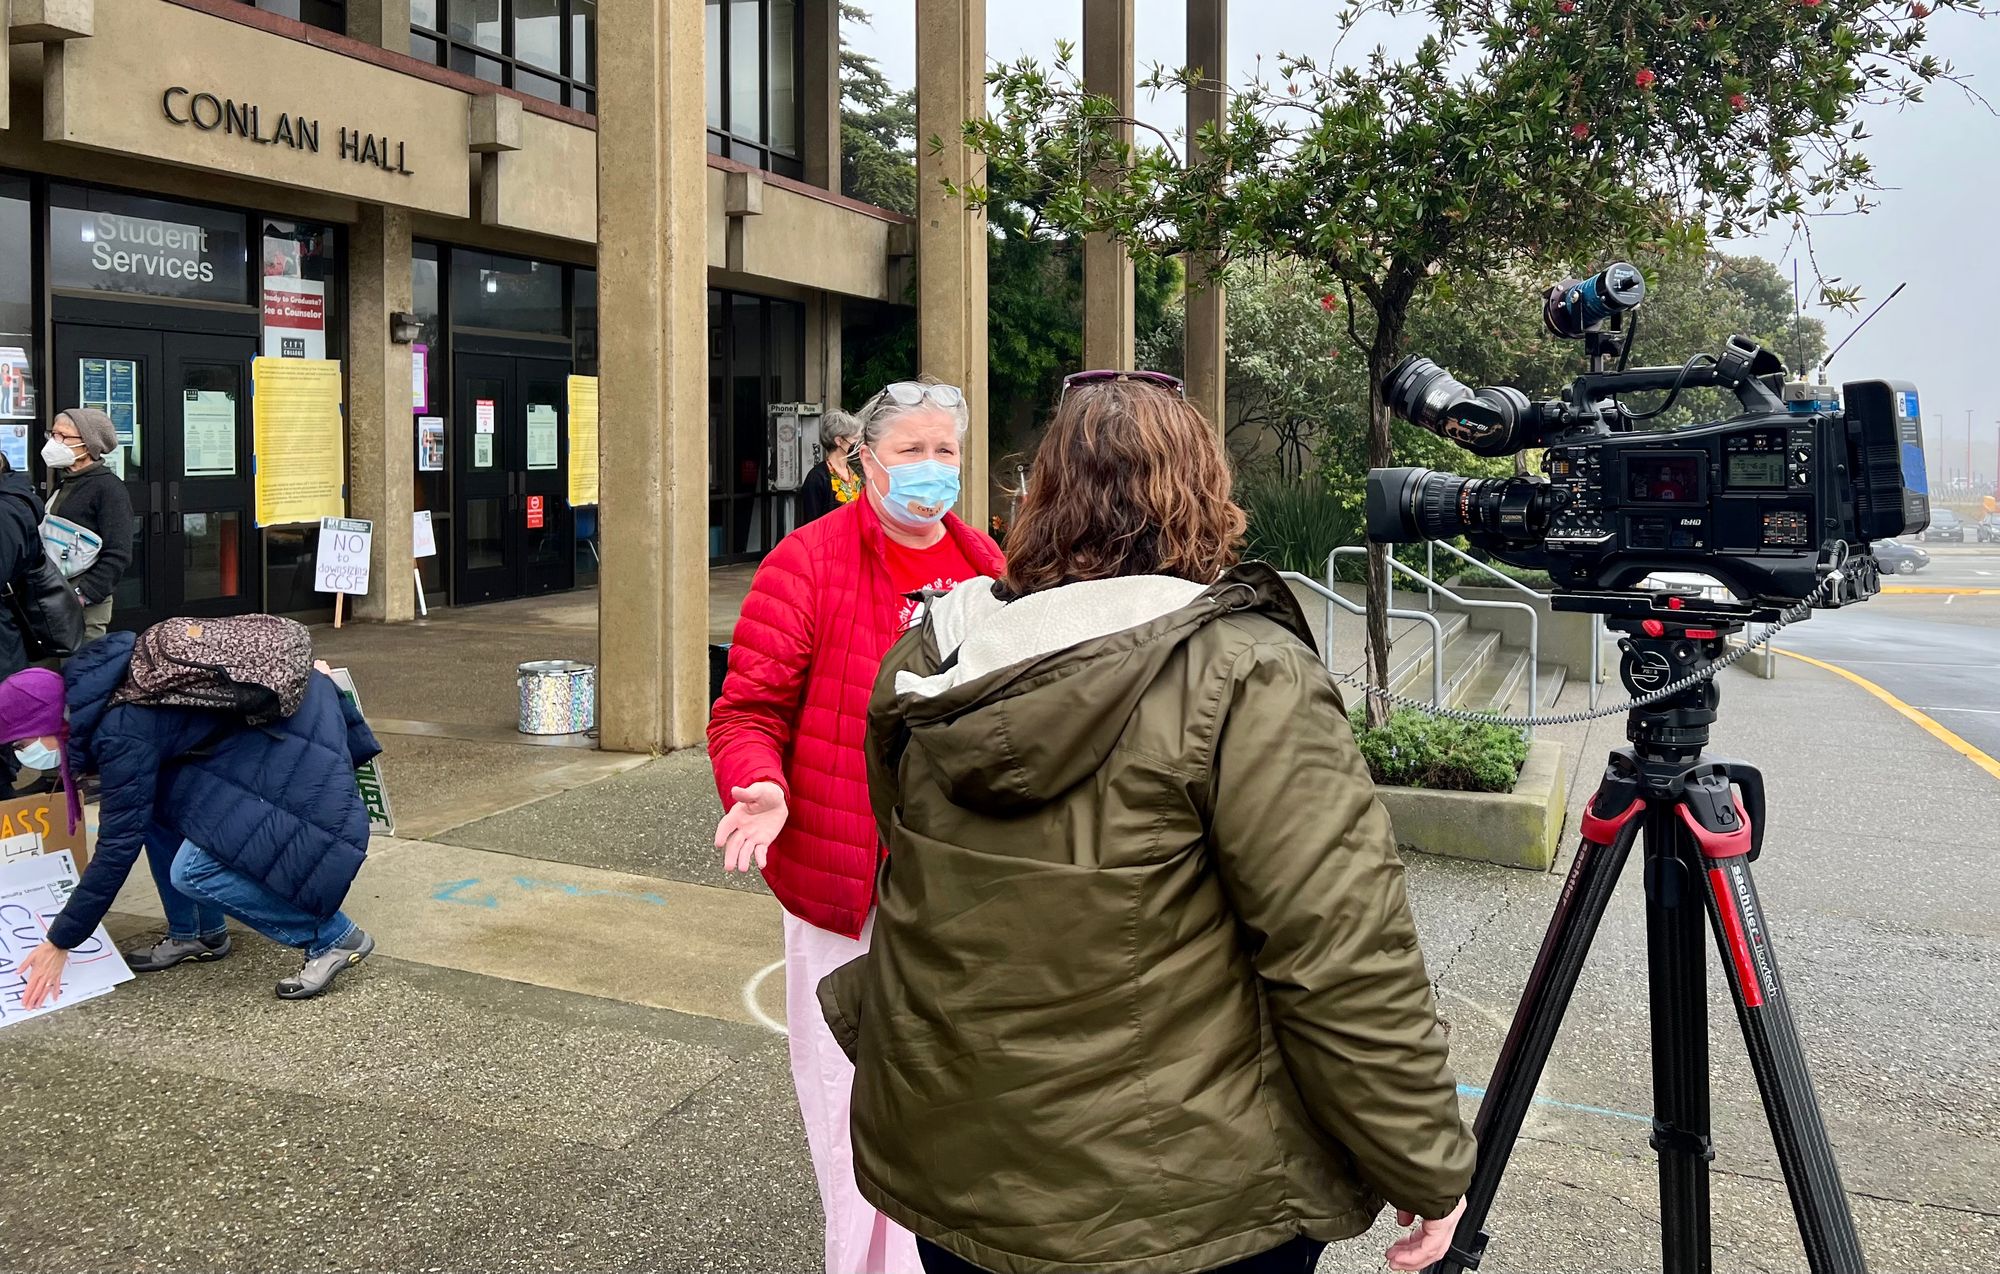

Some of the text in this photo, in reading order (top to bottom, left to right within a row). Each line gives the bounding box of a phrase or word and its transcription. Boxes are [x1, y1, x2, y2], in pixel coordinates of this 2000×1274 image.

[163, 86, 414, 176] CONLAN HALL
[97, 211, 208, 253] Student
[91, 241, 214, 282] Services
[290, 296, 322, 306] Graduate?
[284, 307, 322, 318] Counselor
[283, 340, 303, 348] CITY
[770, 404, 794, 412] Phone
[333, 533, 364, 553] NO
[337, 553, 349, 563] to
[325, 573, 365, 591] CCSF
[1732, 864, 1778, 997] sachtler flowtech
